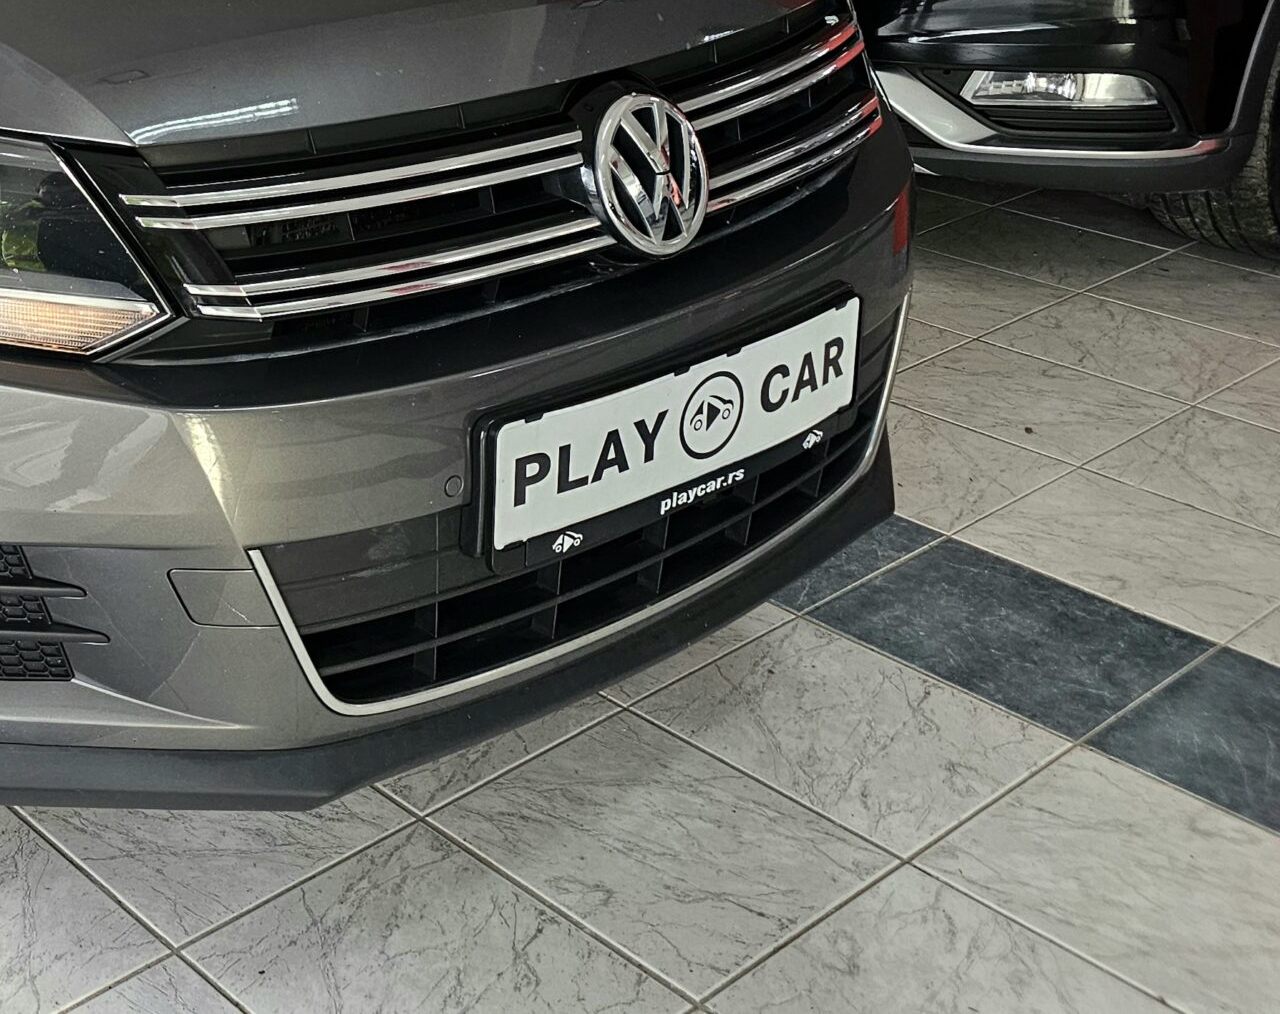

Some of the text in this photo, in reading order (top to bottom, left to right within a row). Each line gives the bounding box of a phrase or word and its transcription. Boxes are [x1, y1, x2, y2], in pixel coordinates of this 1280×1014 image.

[513, 336, 845, 508] PLAY CAR
[658, 467, 746, 516] playcar.rs
